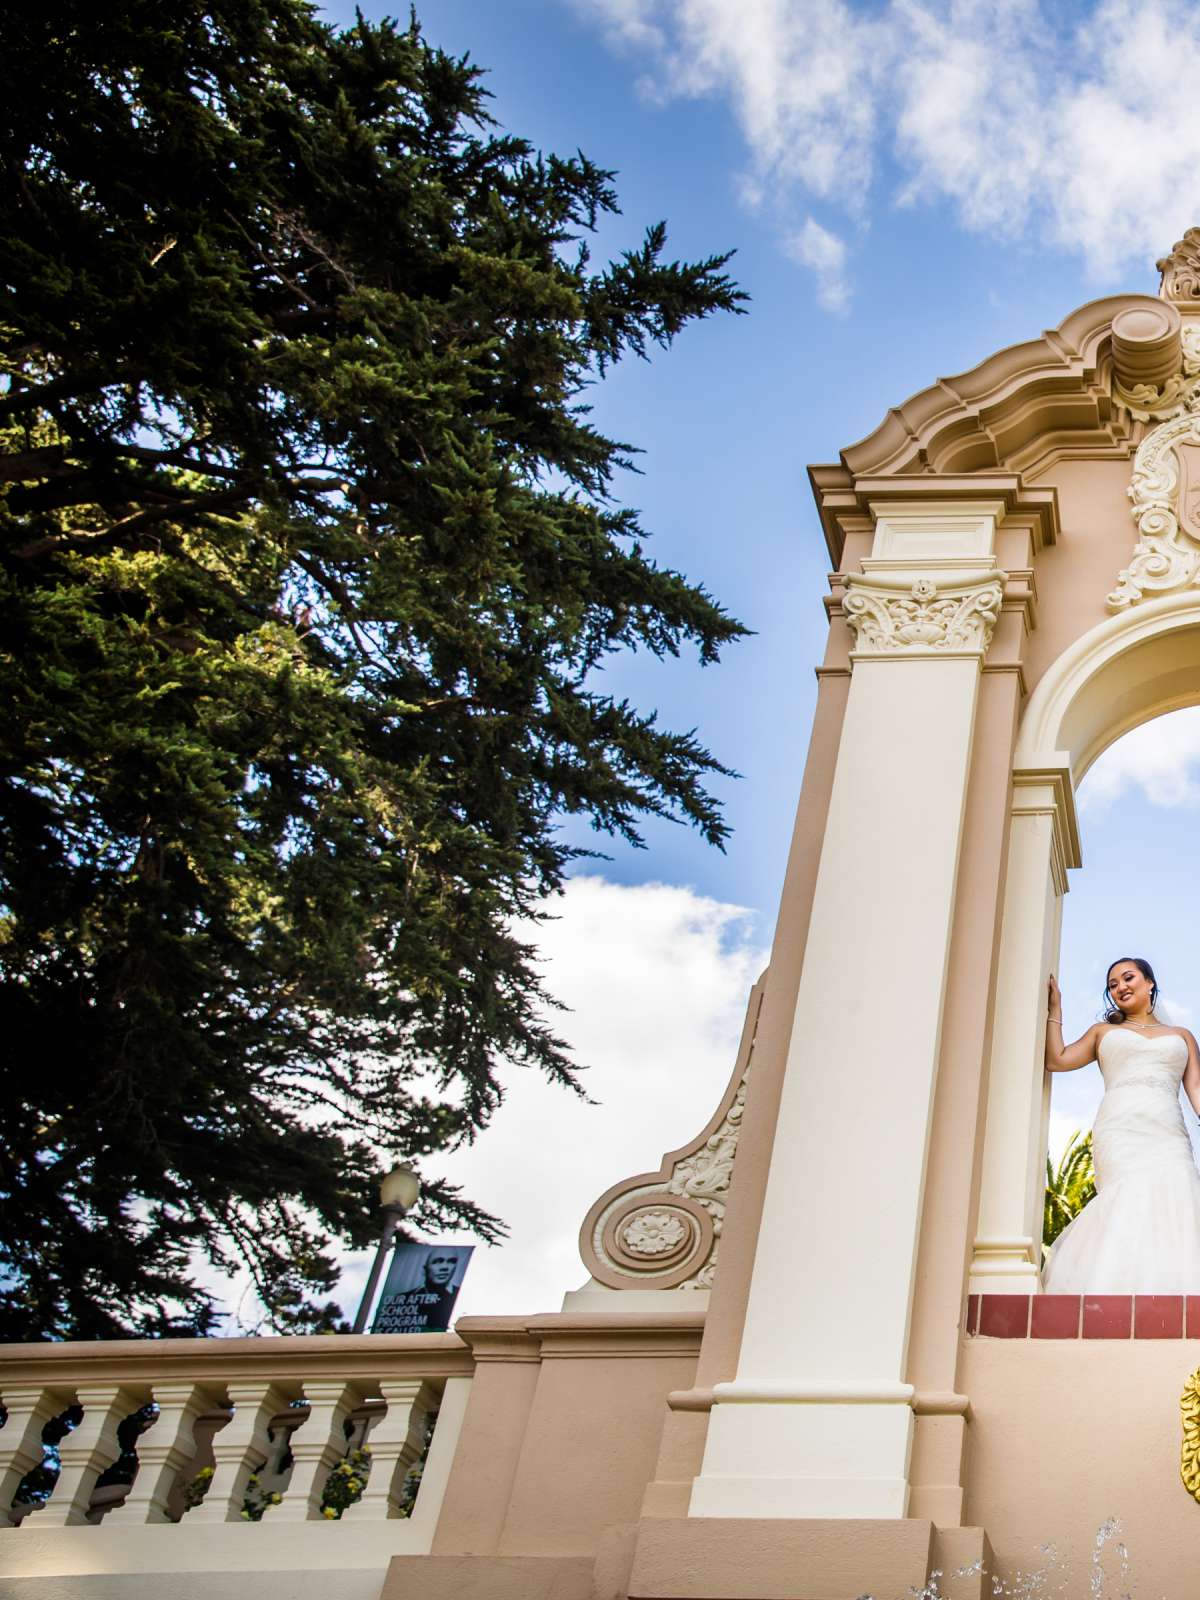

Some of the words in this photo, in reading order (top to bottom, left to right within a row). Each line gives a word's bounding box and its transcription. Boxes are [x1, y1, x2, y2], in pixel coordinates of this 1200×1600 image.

[383, 1294, 406, 1305] OUR
[406, 1293, 441, 1304] AFTER-
[379, 1305, 419, 1316] SCHOOL
[376, 1315, 428, 1327] PROGRAM
